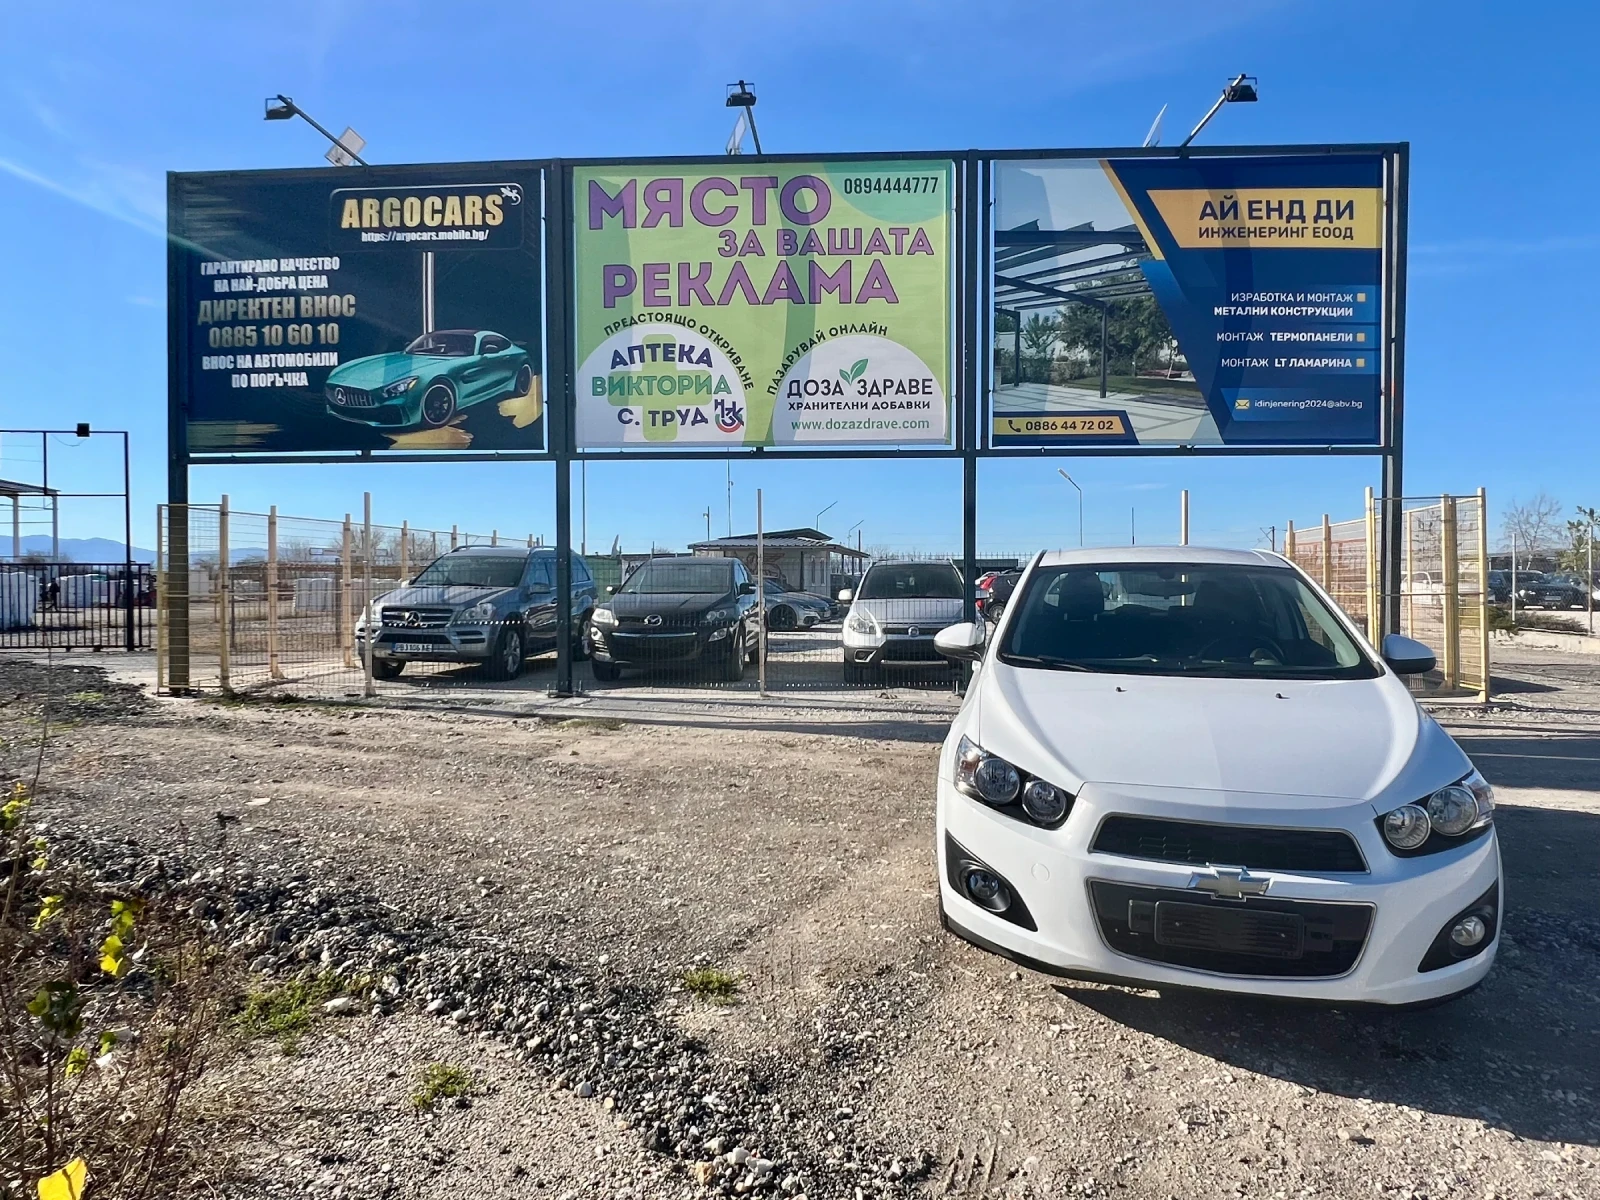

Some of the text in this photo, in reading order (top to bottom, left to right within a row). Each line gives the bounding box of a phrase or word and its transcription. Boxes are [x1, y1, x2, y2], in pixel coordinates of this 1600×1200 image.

[844, 176, 939, 195] 0894444777
[341, 194, 503, 228] ARGOCARS
[588, 175, 832, 230] МЯСТО
[1199, 194, 1355, 224] АЙ ЕНД ДИ
[361, 229, 490, 242] https://argocars.mobile.bg/
[718, 227, 935, 257] ЗА ВАШАТА
[1199, 226, 1354, 241] ИНЖЕНЕРИНГ ЕООД
[201, 256, 340, 275] ГАРАНТИРАНО КАЧЕСТВО
[213, 275, 329, 292] НА НАЙ-ДОБРА ЦЕНА
[602, 258, 900, 308] РЕКЛАМА
[1231, 293, 1353, 302] ИЗРАБОТКА И МОНТАЖ
[197, 294, 356, 325] ДИРЕКТЕН ВНОС
[1214, 306, 1353, 317] МЕТАЛНИ КОНСТРУКЦИИ
[209, 322, 339, 348] 0885 10 60 10
[1216, 332, 1353, 342] МОНТАЖ ТЕРМОПАНЕЛИ
[202, 352, 338, 370] ВНОС НА АВТОМОБИЛИ
[603, 312, 754, 391] ПРЕДСТОЯЩО ОТКРИВАНЕ
[610, 343, 713, 370] АПТЕКА
[766, 321, 888, 395] ПАЗАРУВАЙ ОНЛАЙН
[1221, 358, 1352, 367] МОНТАЖ LT ЛАМАРИНА
[231, 372, 308, 388] ПО ПОРЪЧКА
[592, 374, 732, 396] ВИКТОРИА
[787, 378, 933, 398] ДОЗА ЗДРАВЕ
[788, 401, 930, 411] ХРАНИТЕЛНИ ДОБАВКИ
[617, 407, 708, 427] С. ТРУД
[791, 418, 930, 430] www.dozazdrave.com
[1025, 420, 1114, 431] 0886 44 72 02
